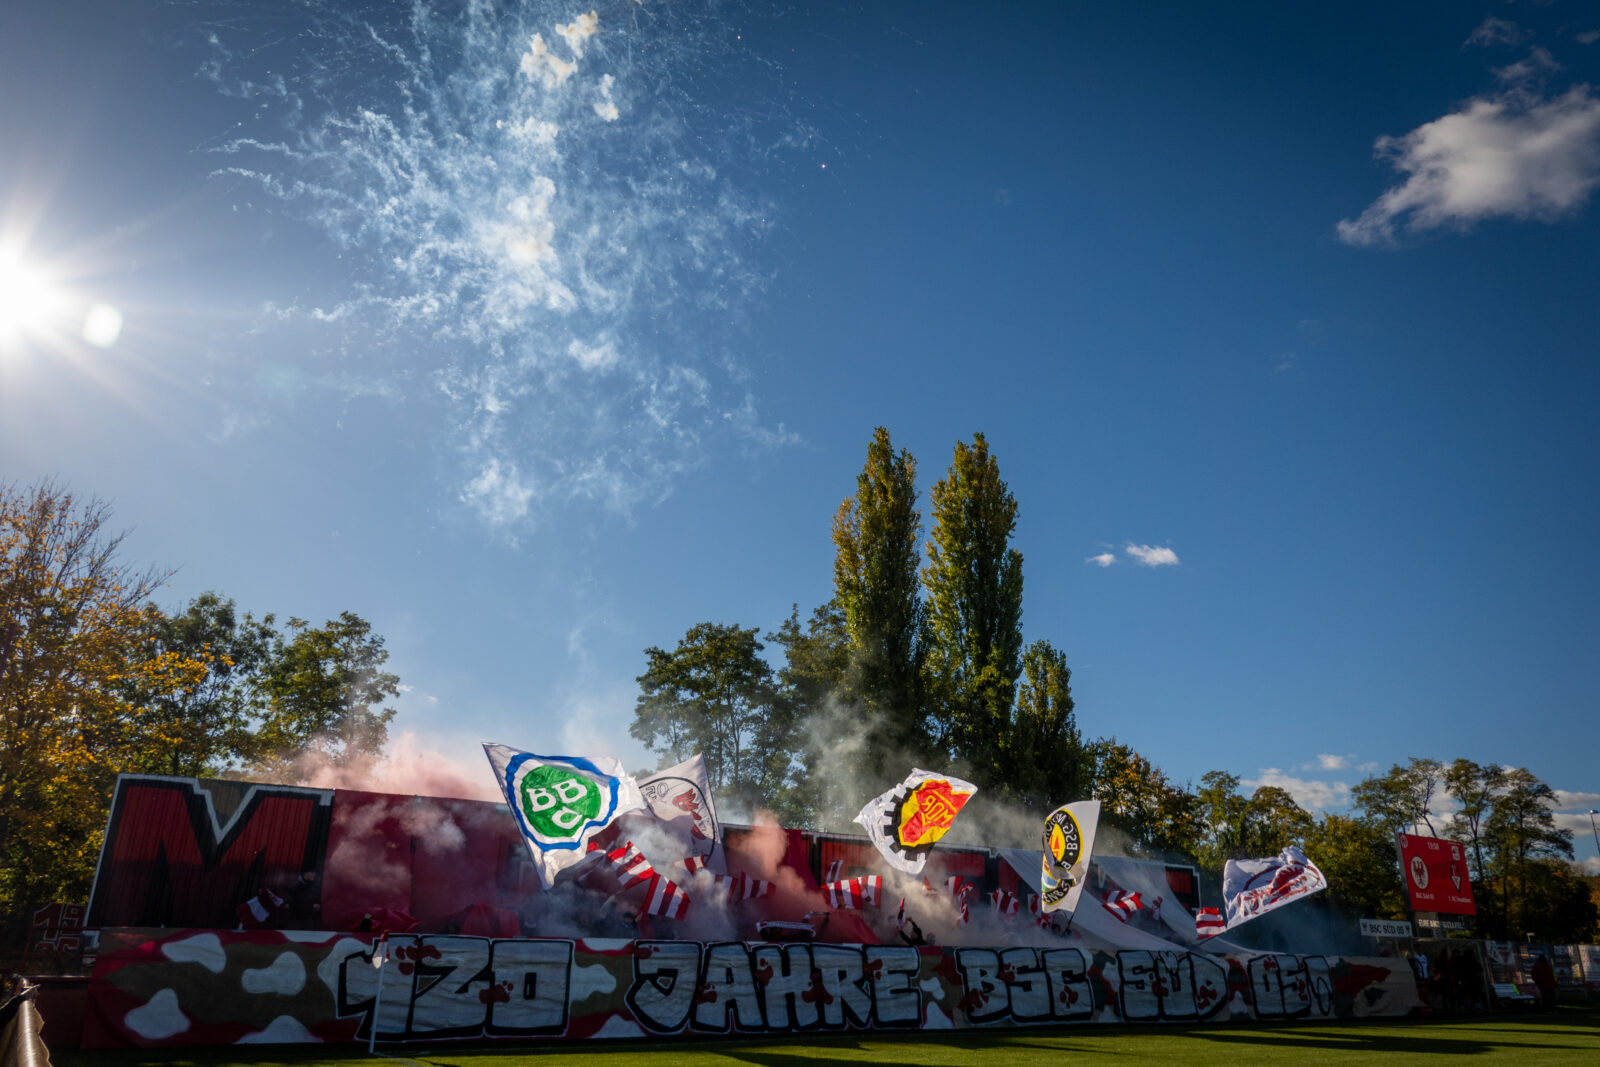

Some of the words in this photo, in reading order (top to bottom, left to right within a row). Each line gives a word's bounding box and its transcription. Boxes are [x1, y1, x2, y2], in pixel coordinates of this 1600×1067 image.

[1369, 923, 1382, 933] BSC
[337, 934, 575, 1041] 120
[629, 940, 921, 1033] JAHRE
[955, 946, 1094, 1024] BSC
[1117, 950, 1230, 1022] SÜD
